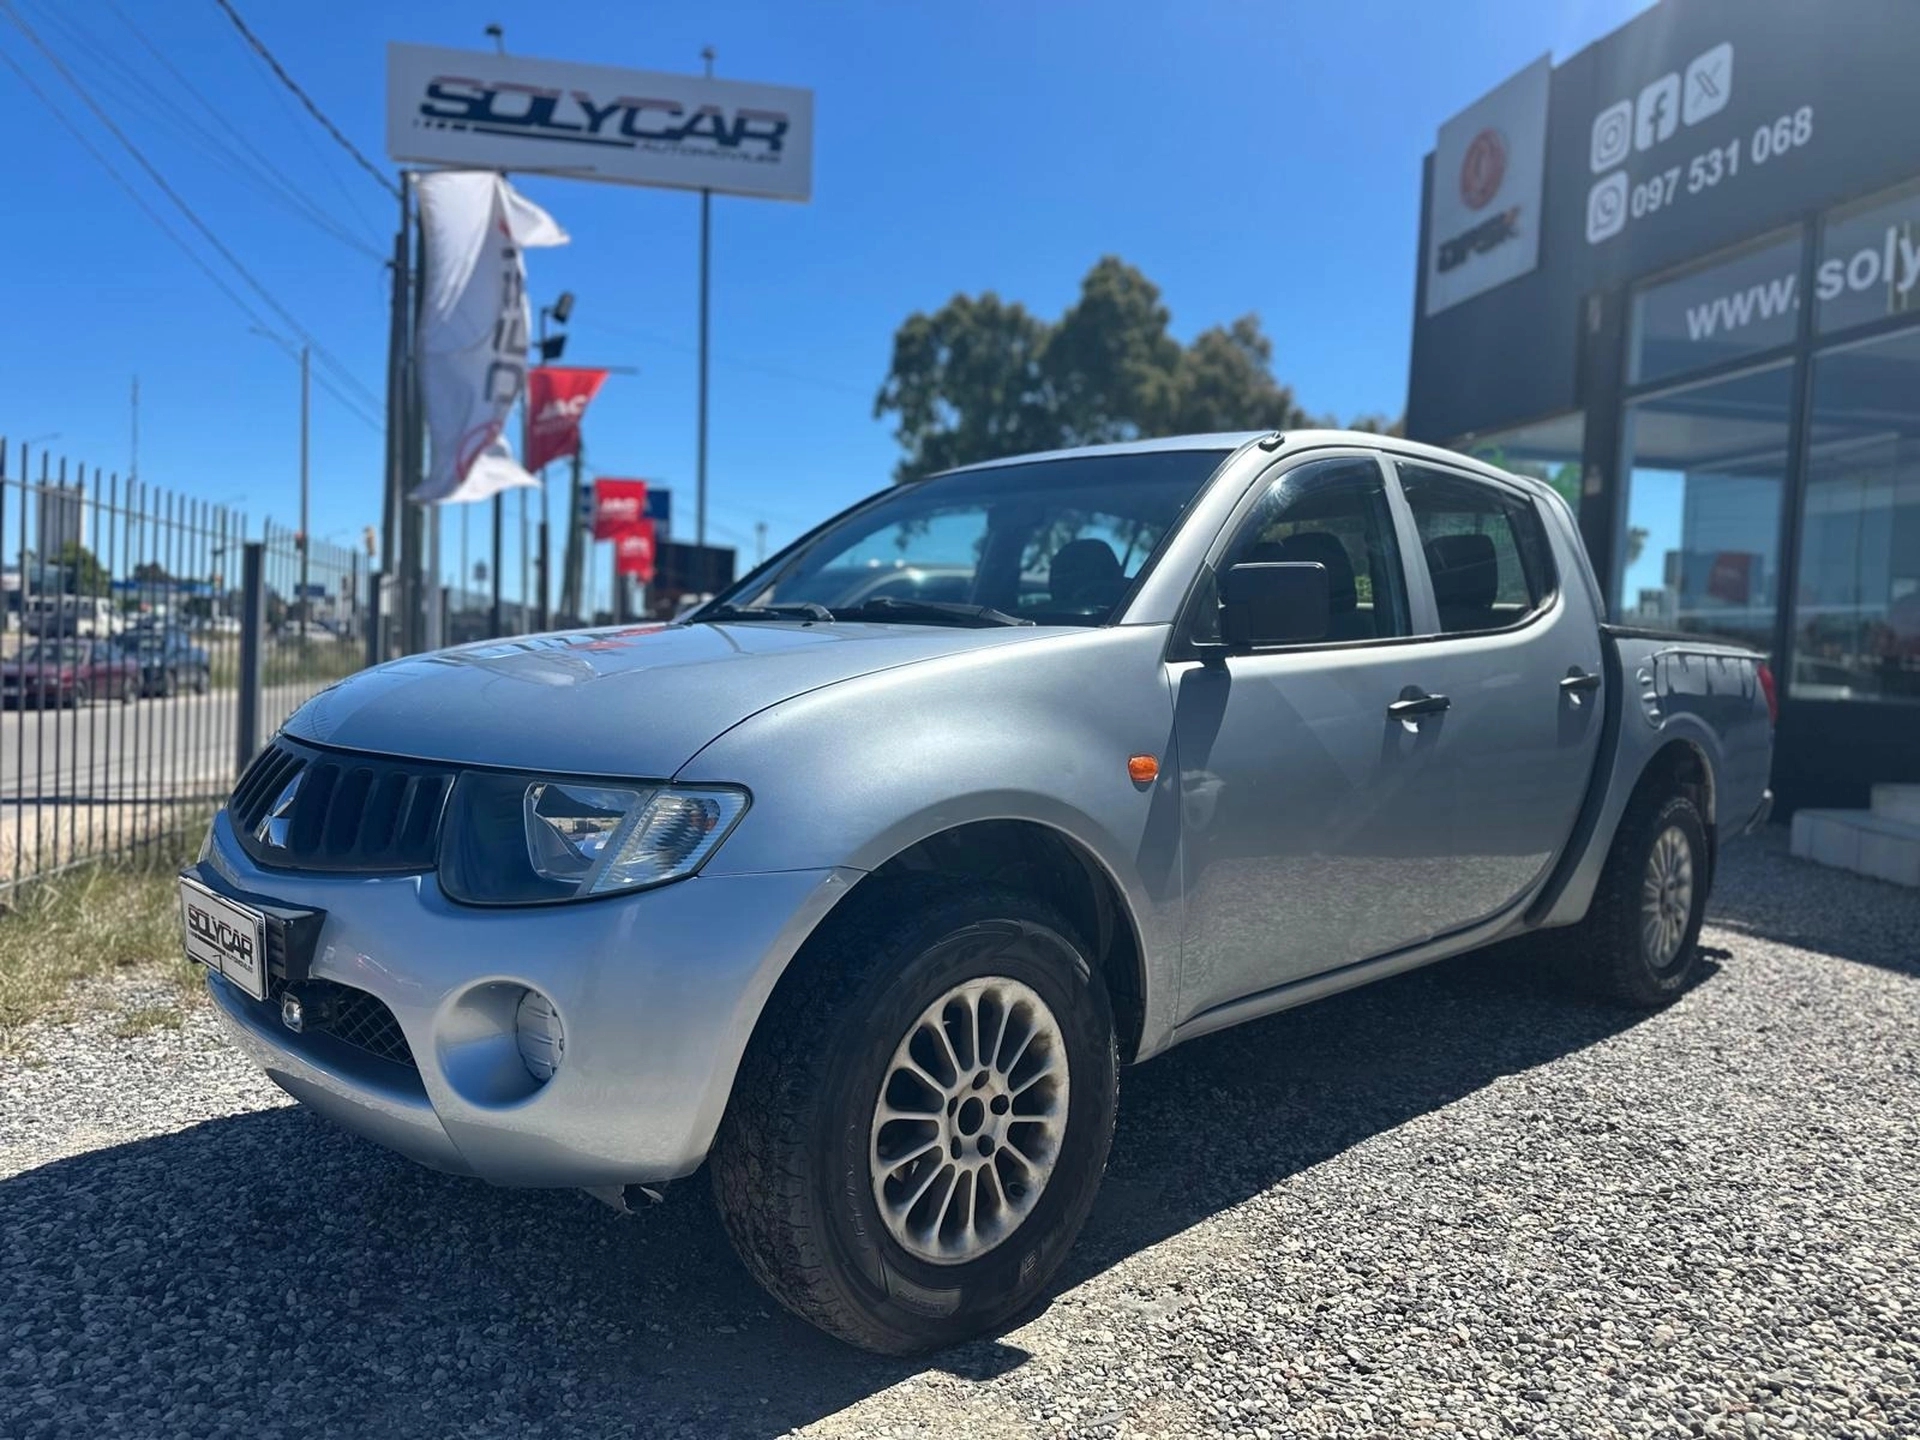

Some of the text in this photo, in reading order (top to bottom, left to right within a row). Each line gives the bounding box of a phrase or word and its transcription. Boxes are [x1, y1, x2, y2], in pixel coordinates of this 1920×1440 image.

[419, 76, 788, 150] SOLYCAR
[1631, 105, 1813, 219] 097 531 068
[1686, 273, 1799, 341] www.
[188, 904, 252, 965] SOLYCAR
